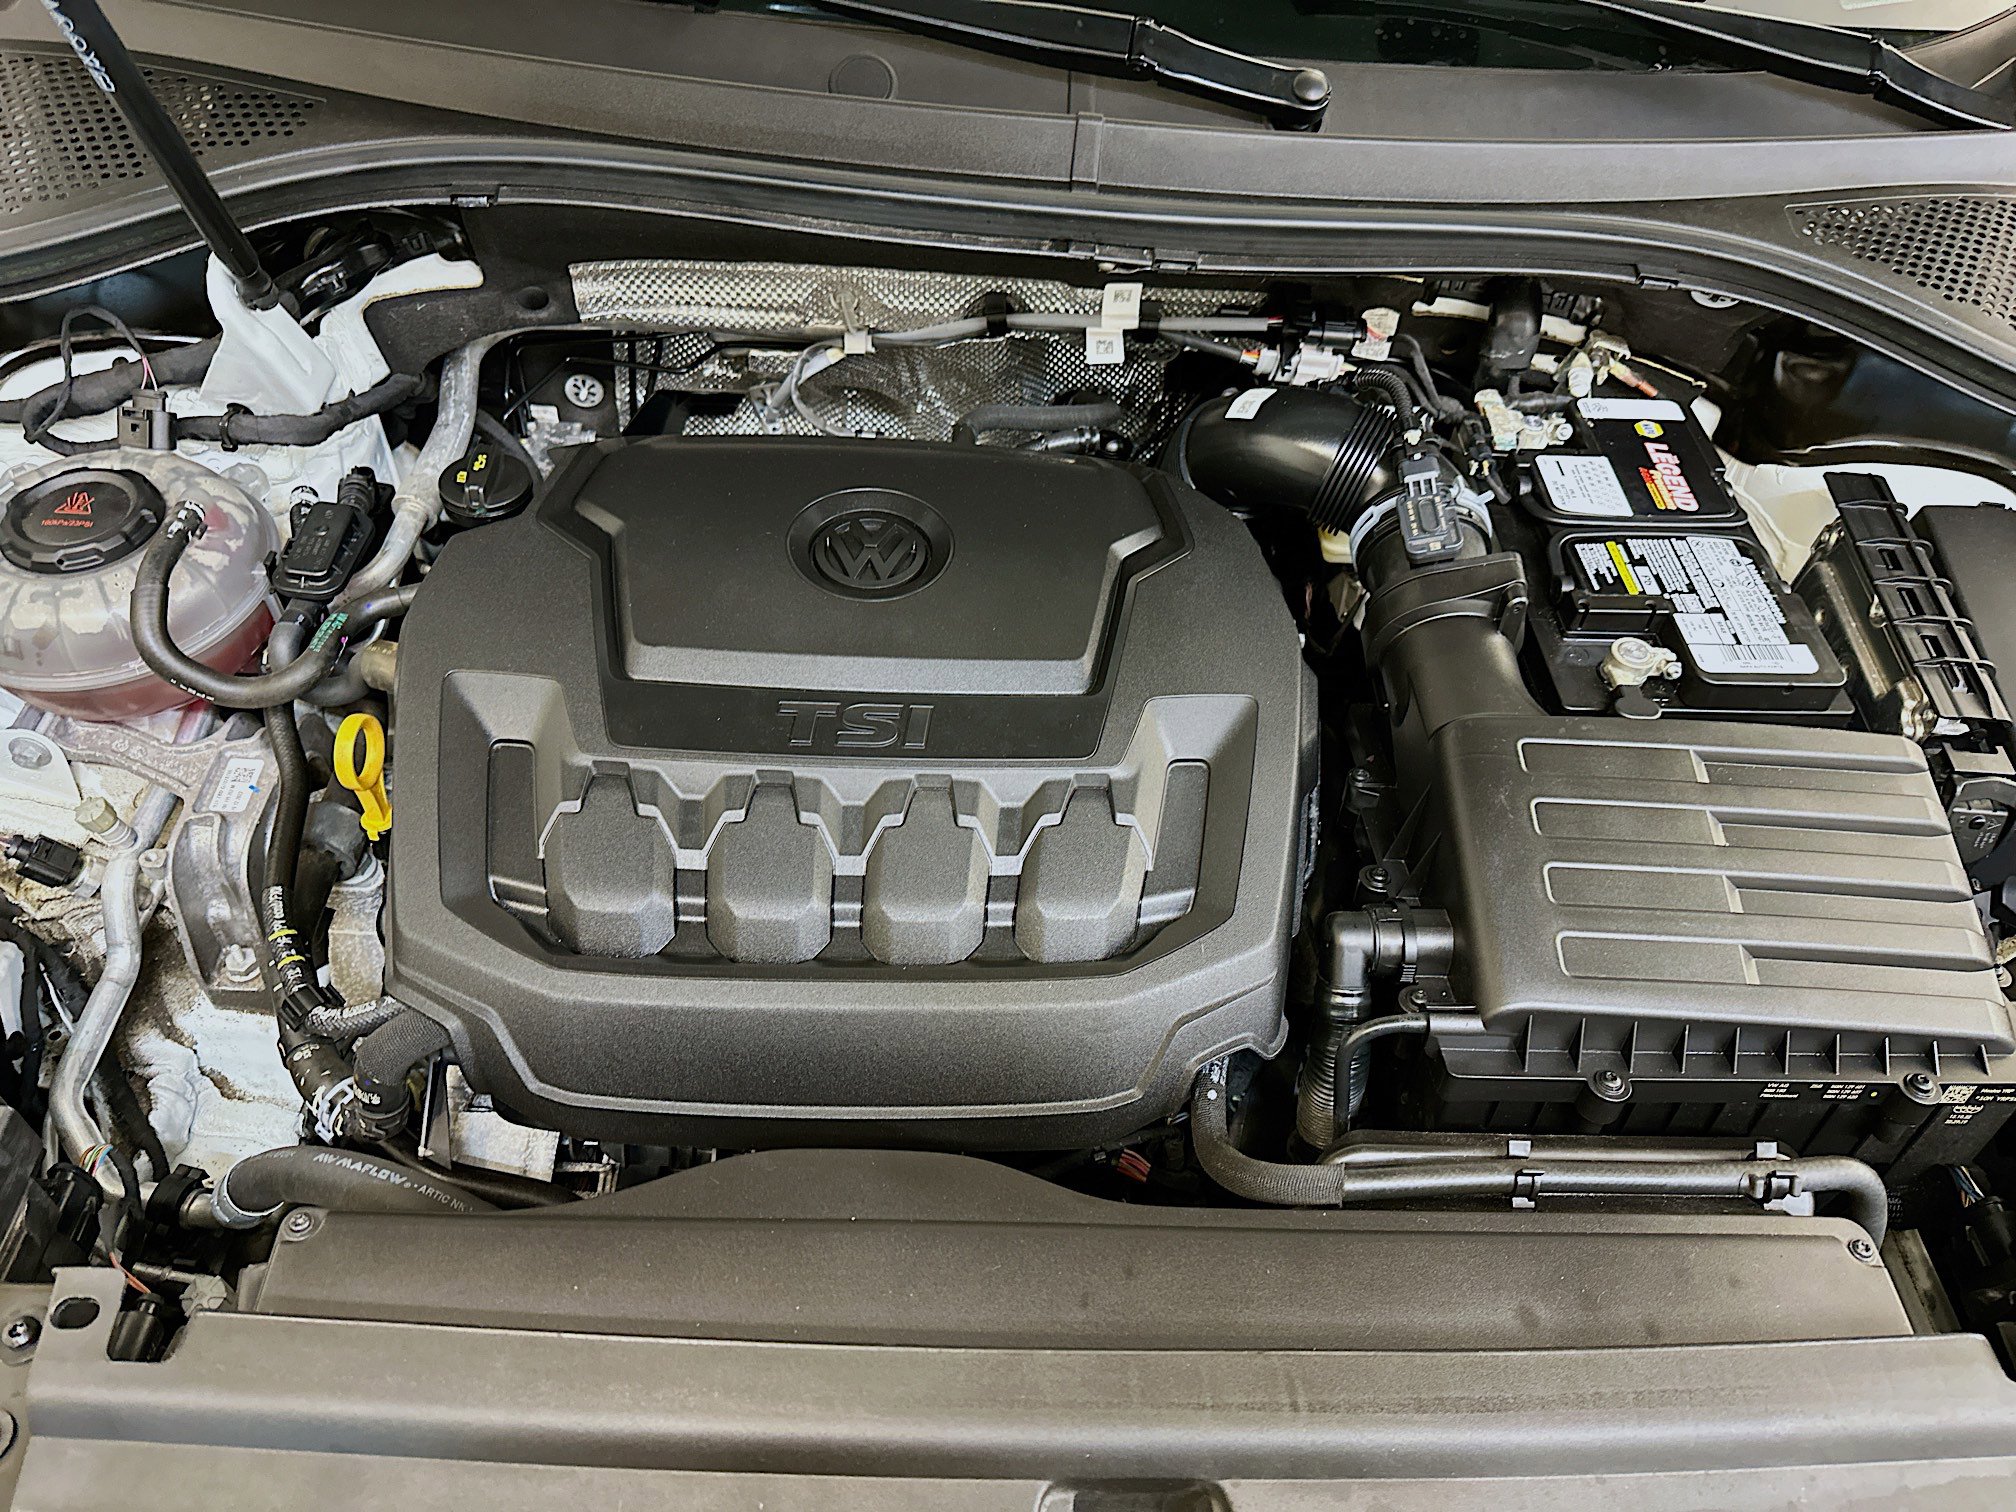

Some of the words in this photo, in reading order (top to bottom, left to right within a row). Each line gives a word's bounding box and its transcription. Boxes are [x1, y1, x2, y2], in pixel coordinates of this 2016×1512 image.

[777, 700, 935, 749] TSI
[336, 1157, 408, 1185] MAFLOW
[417, 1184, 451, 1205] ARTIC
